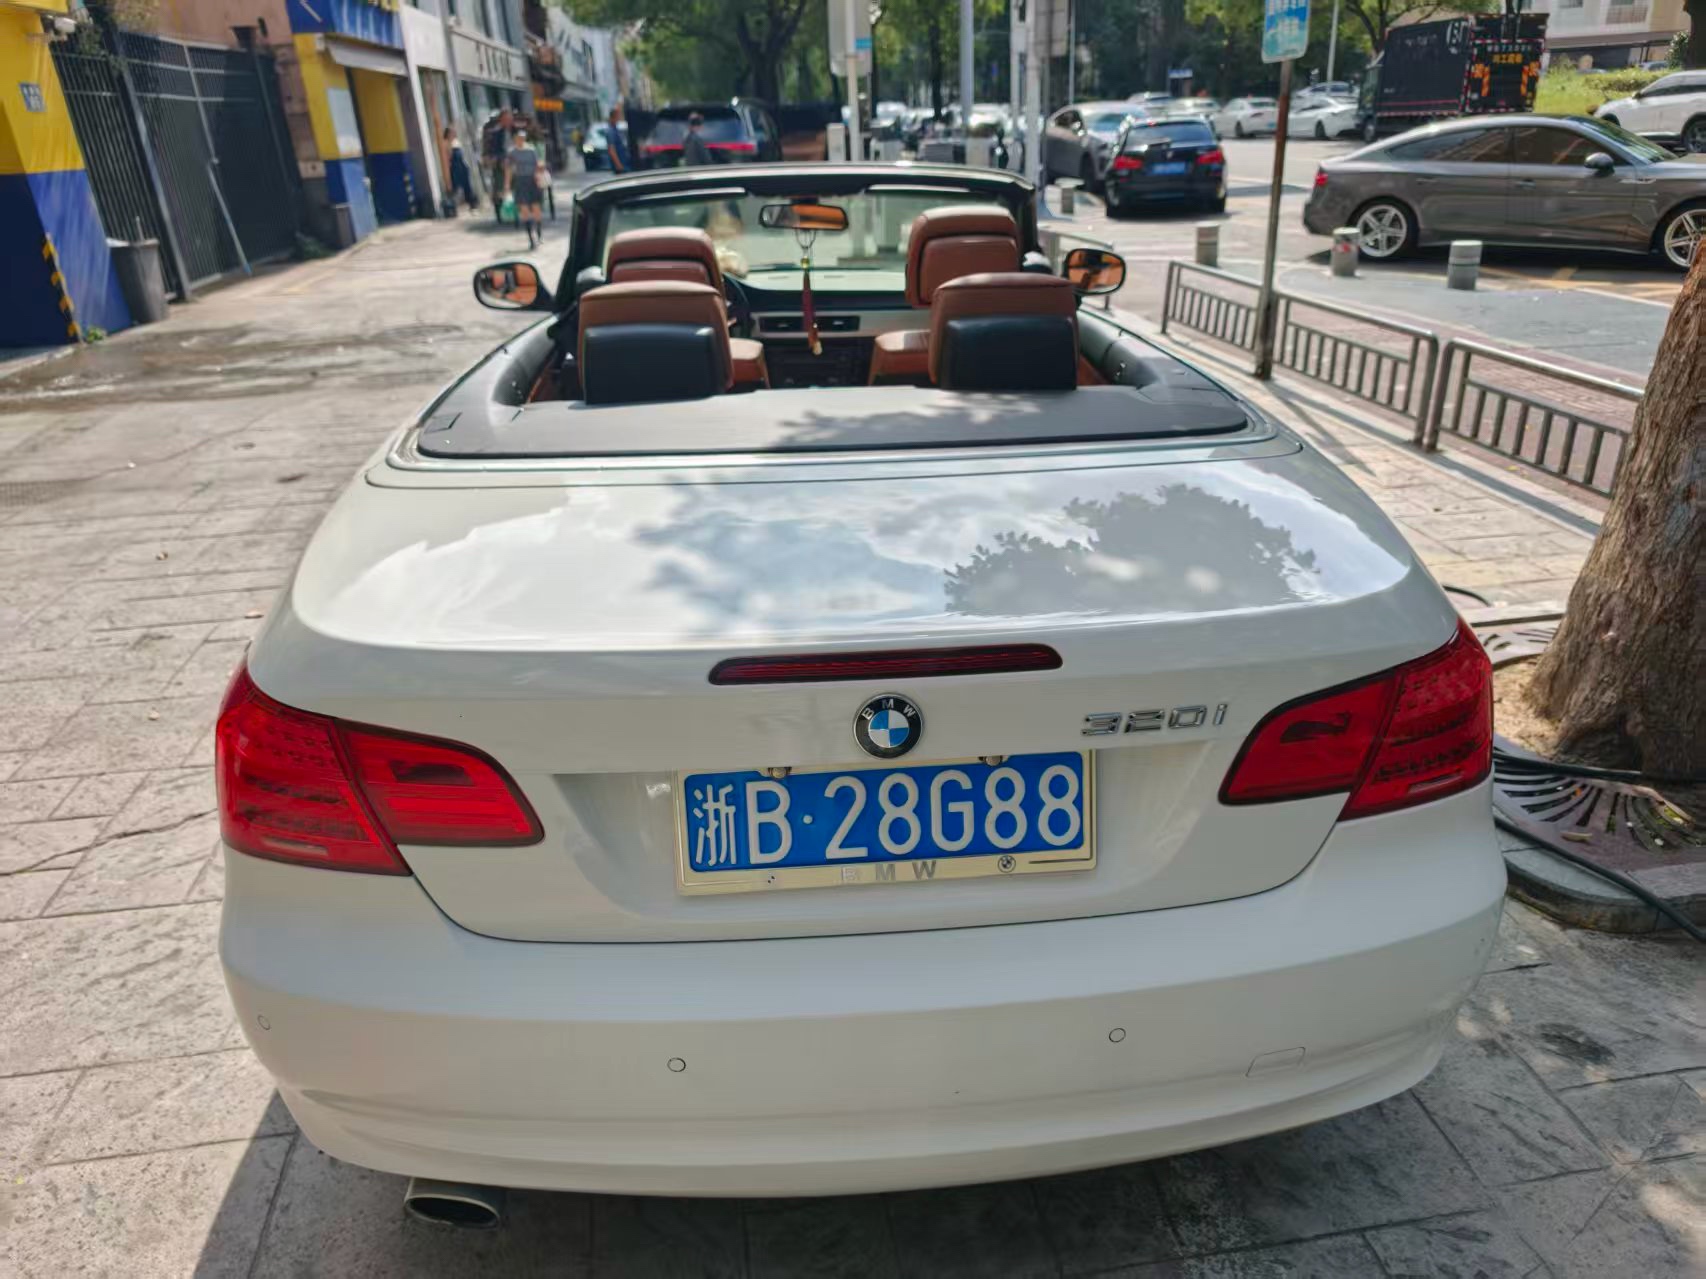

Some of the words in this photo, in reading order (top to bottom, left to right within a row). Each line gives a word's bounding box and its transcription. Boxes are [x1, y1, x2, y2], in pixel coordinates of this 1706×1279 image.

[862, 698, 915, 720] BMW
[1081, 704, 1227, 736] 320i
[693, 765, 1080, 866] 浙B·28G88
[841, 860, 936, 881] BMW
